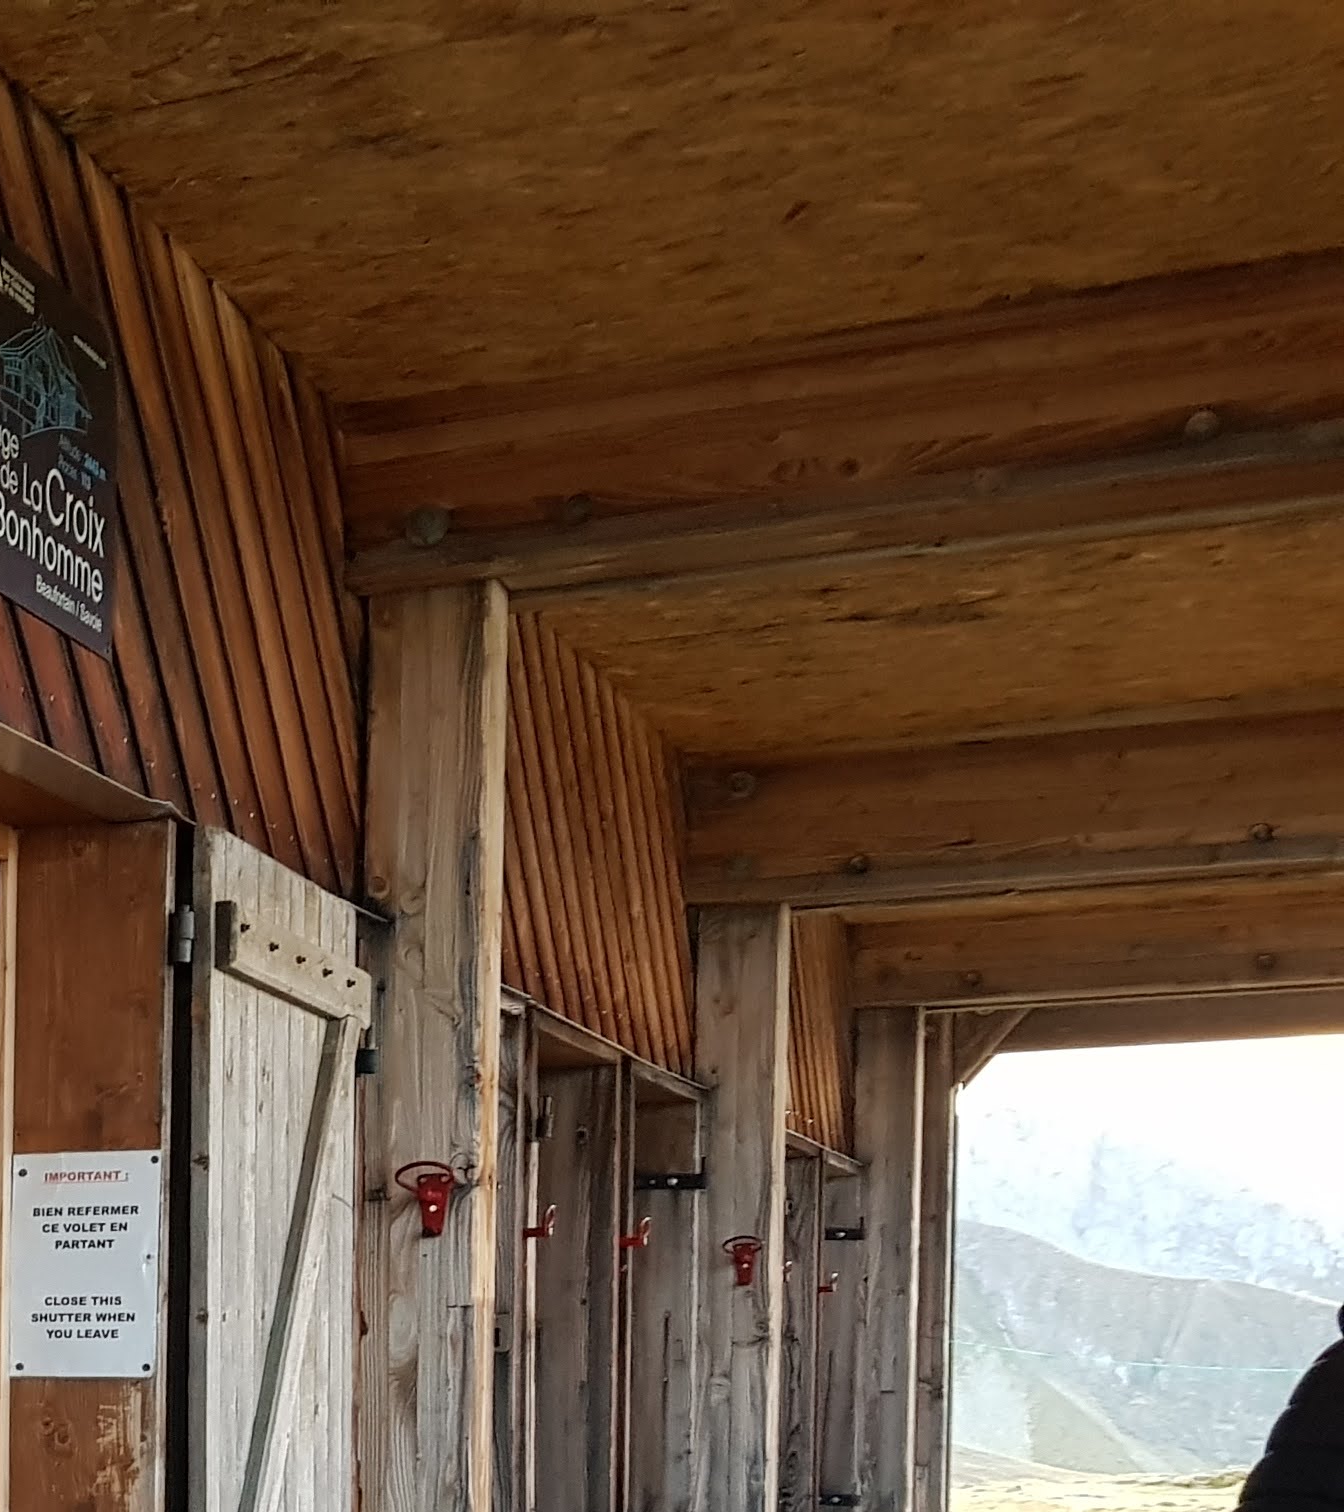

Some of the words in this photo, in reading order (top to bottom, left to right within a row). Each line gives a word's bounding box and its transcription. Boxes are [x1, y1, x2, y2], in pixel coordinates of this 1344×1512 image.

[0, 461, 19, 495] de
[22, 462, 43, 513] La
[45, 468, 105, 558] Croix
[44, 1170, 121, 1183] IMPORTANT
[32, 1206, 64, 1217] BIEN
[67, 1205, 140, 1216] REFERMER
[42, 1223, 60, 1233] CE
[63, 1222, 107, 1233] VOLET
[110, 1221, 128, 1232] EN
[54, 1239, 116, 1250] PARTANT
[44, 1296, 88, 1306] CLOSE
[91, 1295, 123, 1306] THIS
[31, 1312, 92, 1323] SHUTTER
[95, 1312, 136, 1322] WHEN
[46, 1328, 73, 1339] YOU
[77, 1328, 119, 1339] LEAVE
